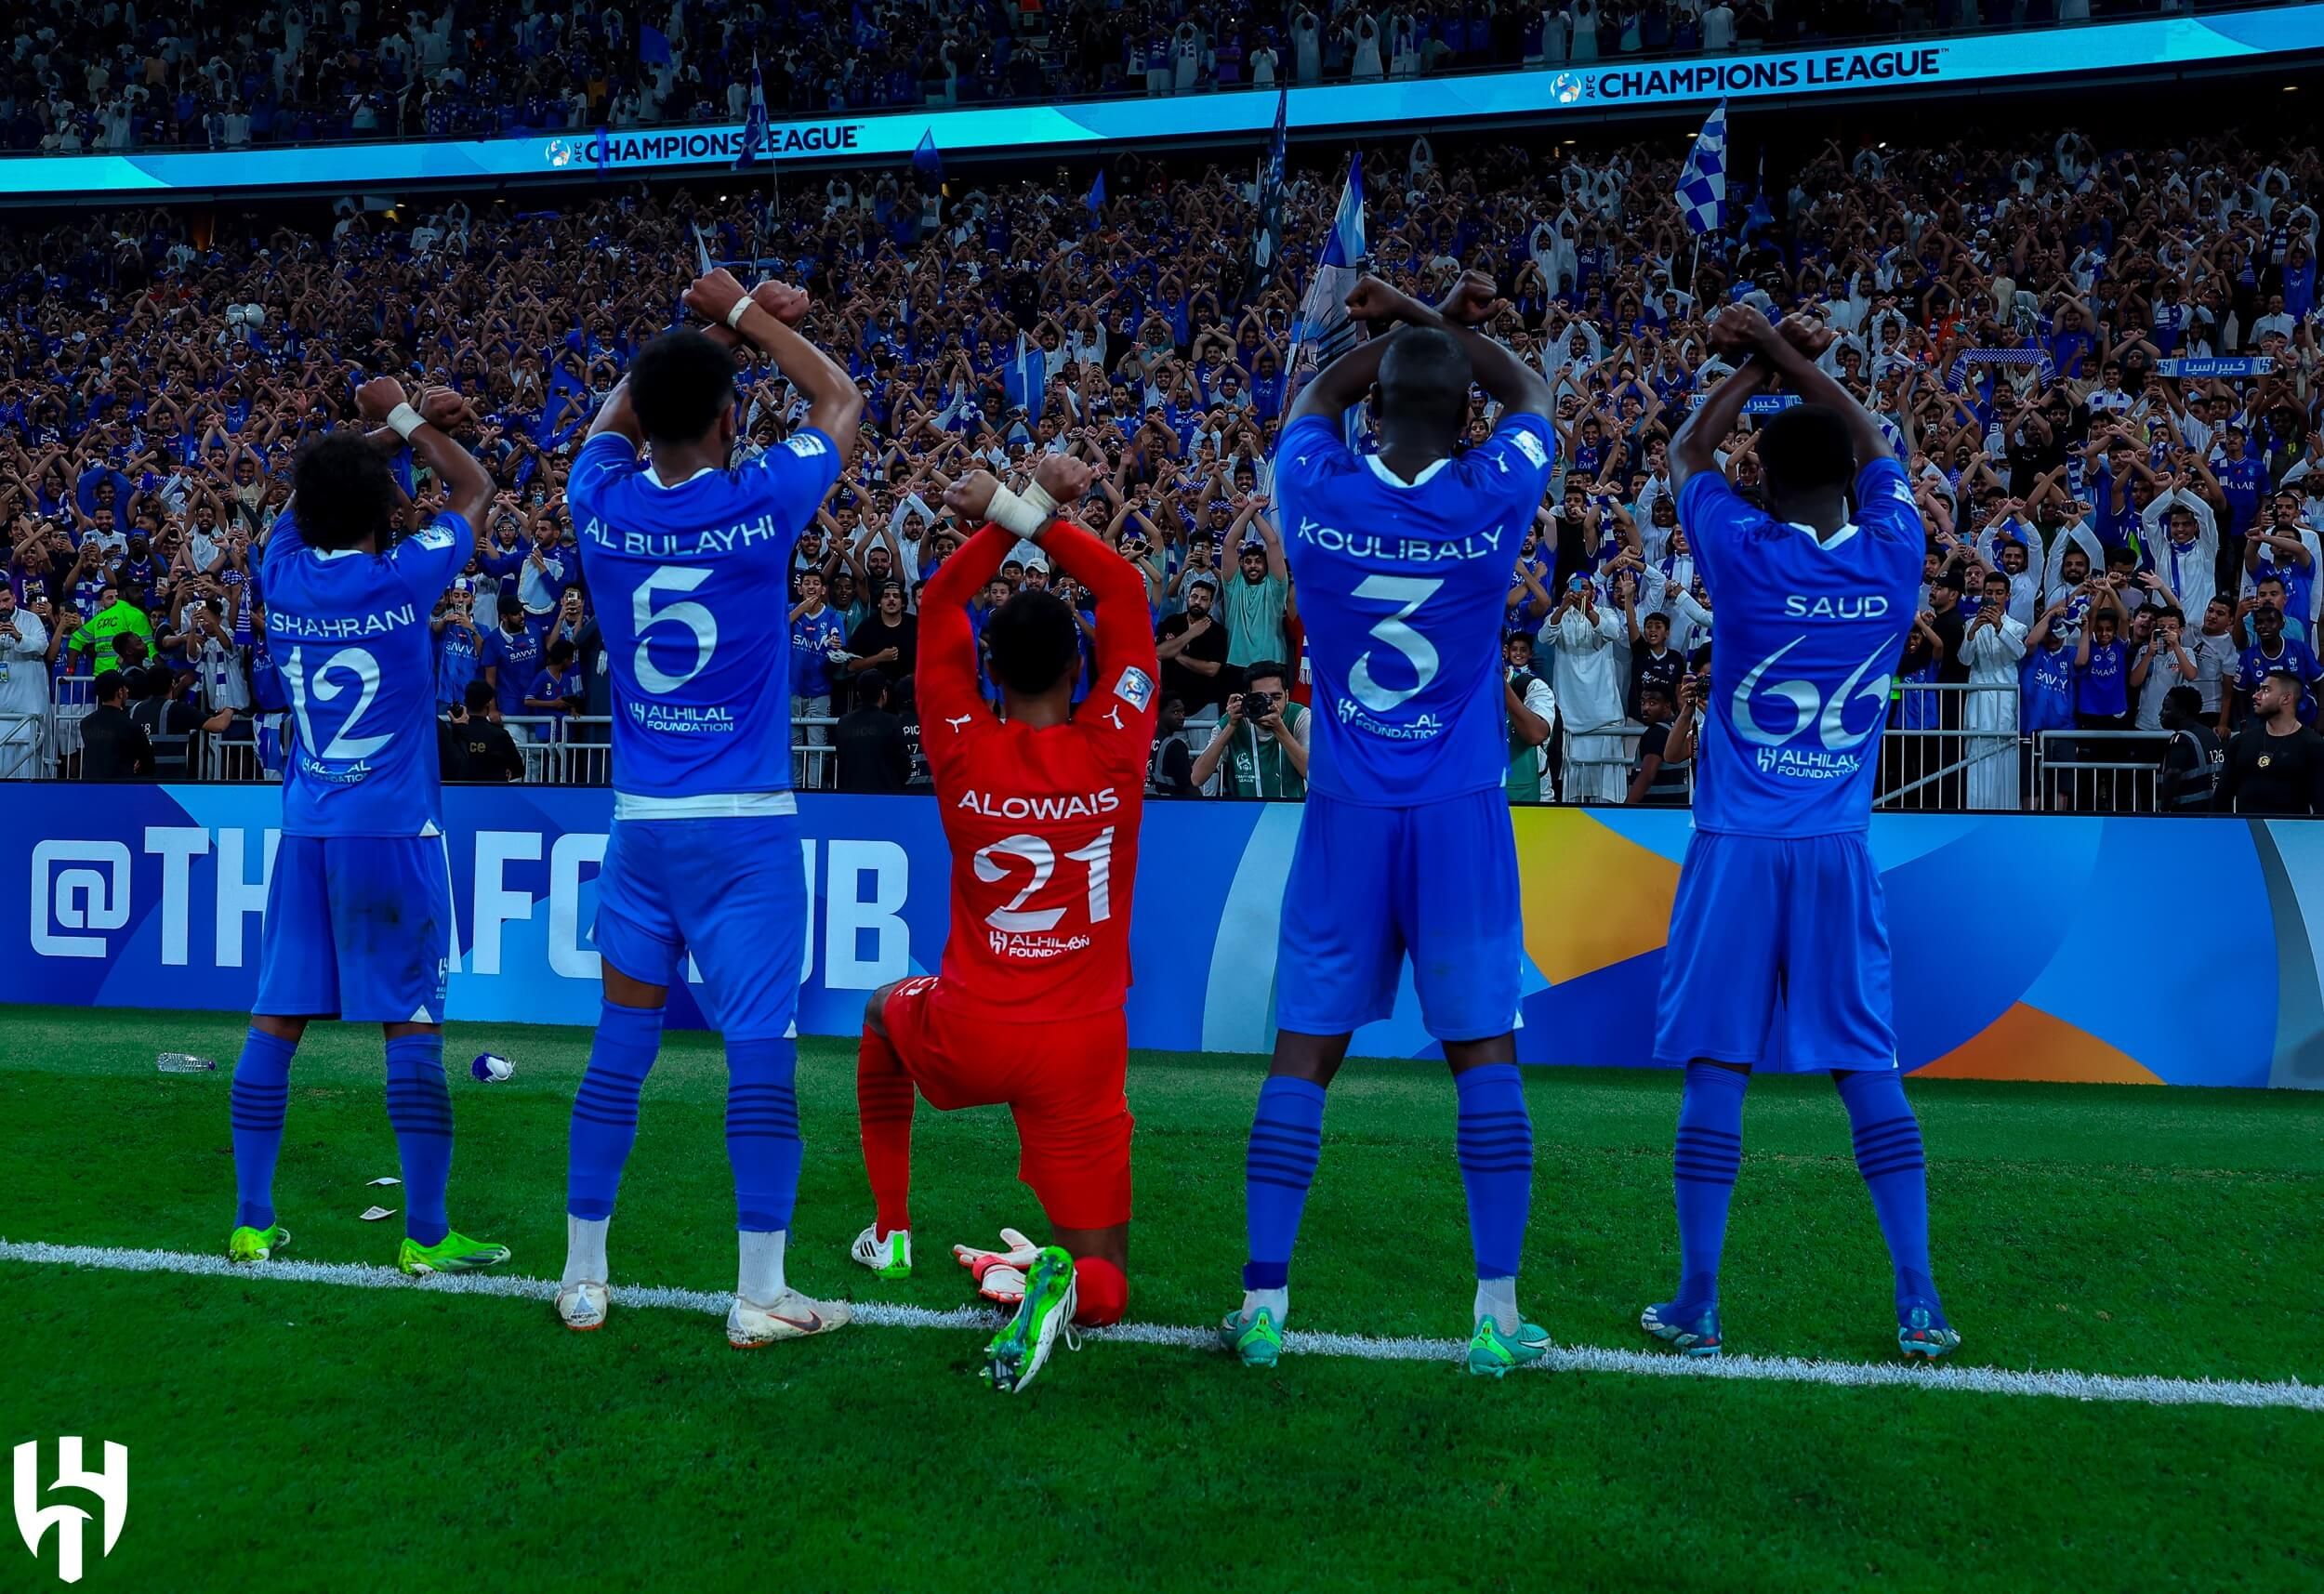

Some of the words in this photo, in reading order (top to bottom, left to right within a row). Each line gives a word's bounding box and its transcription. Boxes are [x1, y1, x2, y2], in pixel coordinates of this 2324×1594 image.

[1586, 74, 1596, 99] AFC
[1599, 59, 1799, 99] CHAMPIONS
[574, 141, 583, 164] AFC
[584, 516, 617, 549] AL
[624, 514, 776, 557] BULAYHI
[1298, 516, 1504, 562] KOULIBALY
[271, 603, 416, 639] SHAHRANI
[1784, 595, 1889, 620] SAUD
[632, 564, 719, 695] 5
[1348, 573, 1446, 713] 3
[279, 646, 395, 759] 12
[1731, 631, 1899, 751] 66
[647, 705, 734, 721] ALHILAL
[647, 720, 734, 733] FOUNDATION
[957, 787, 1120, 821] ALOWAIS
[973, 824, 1116, 933] 21
